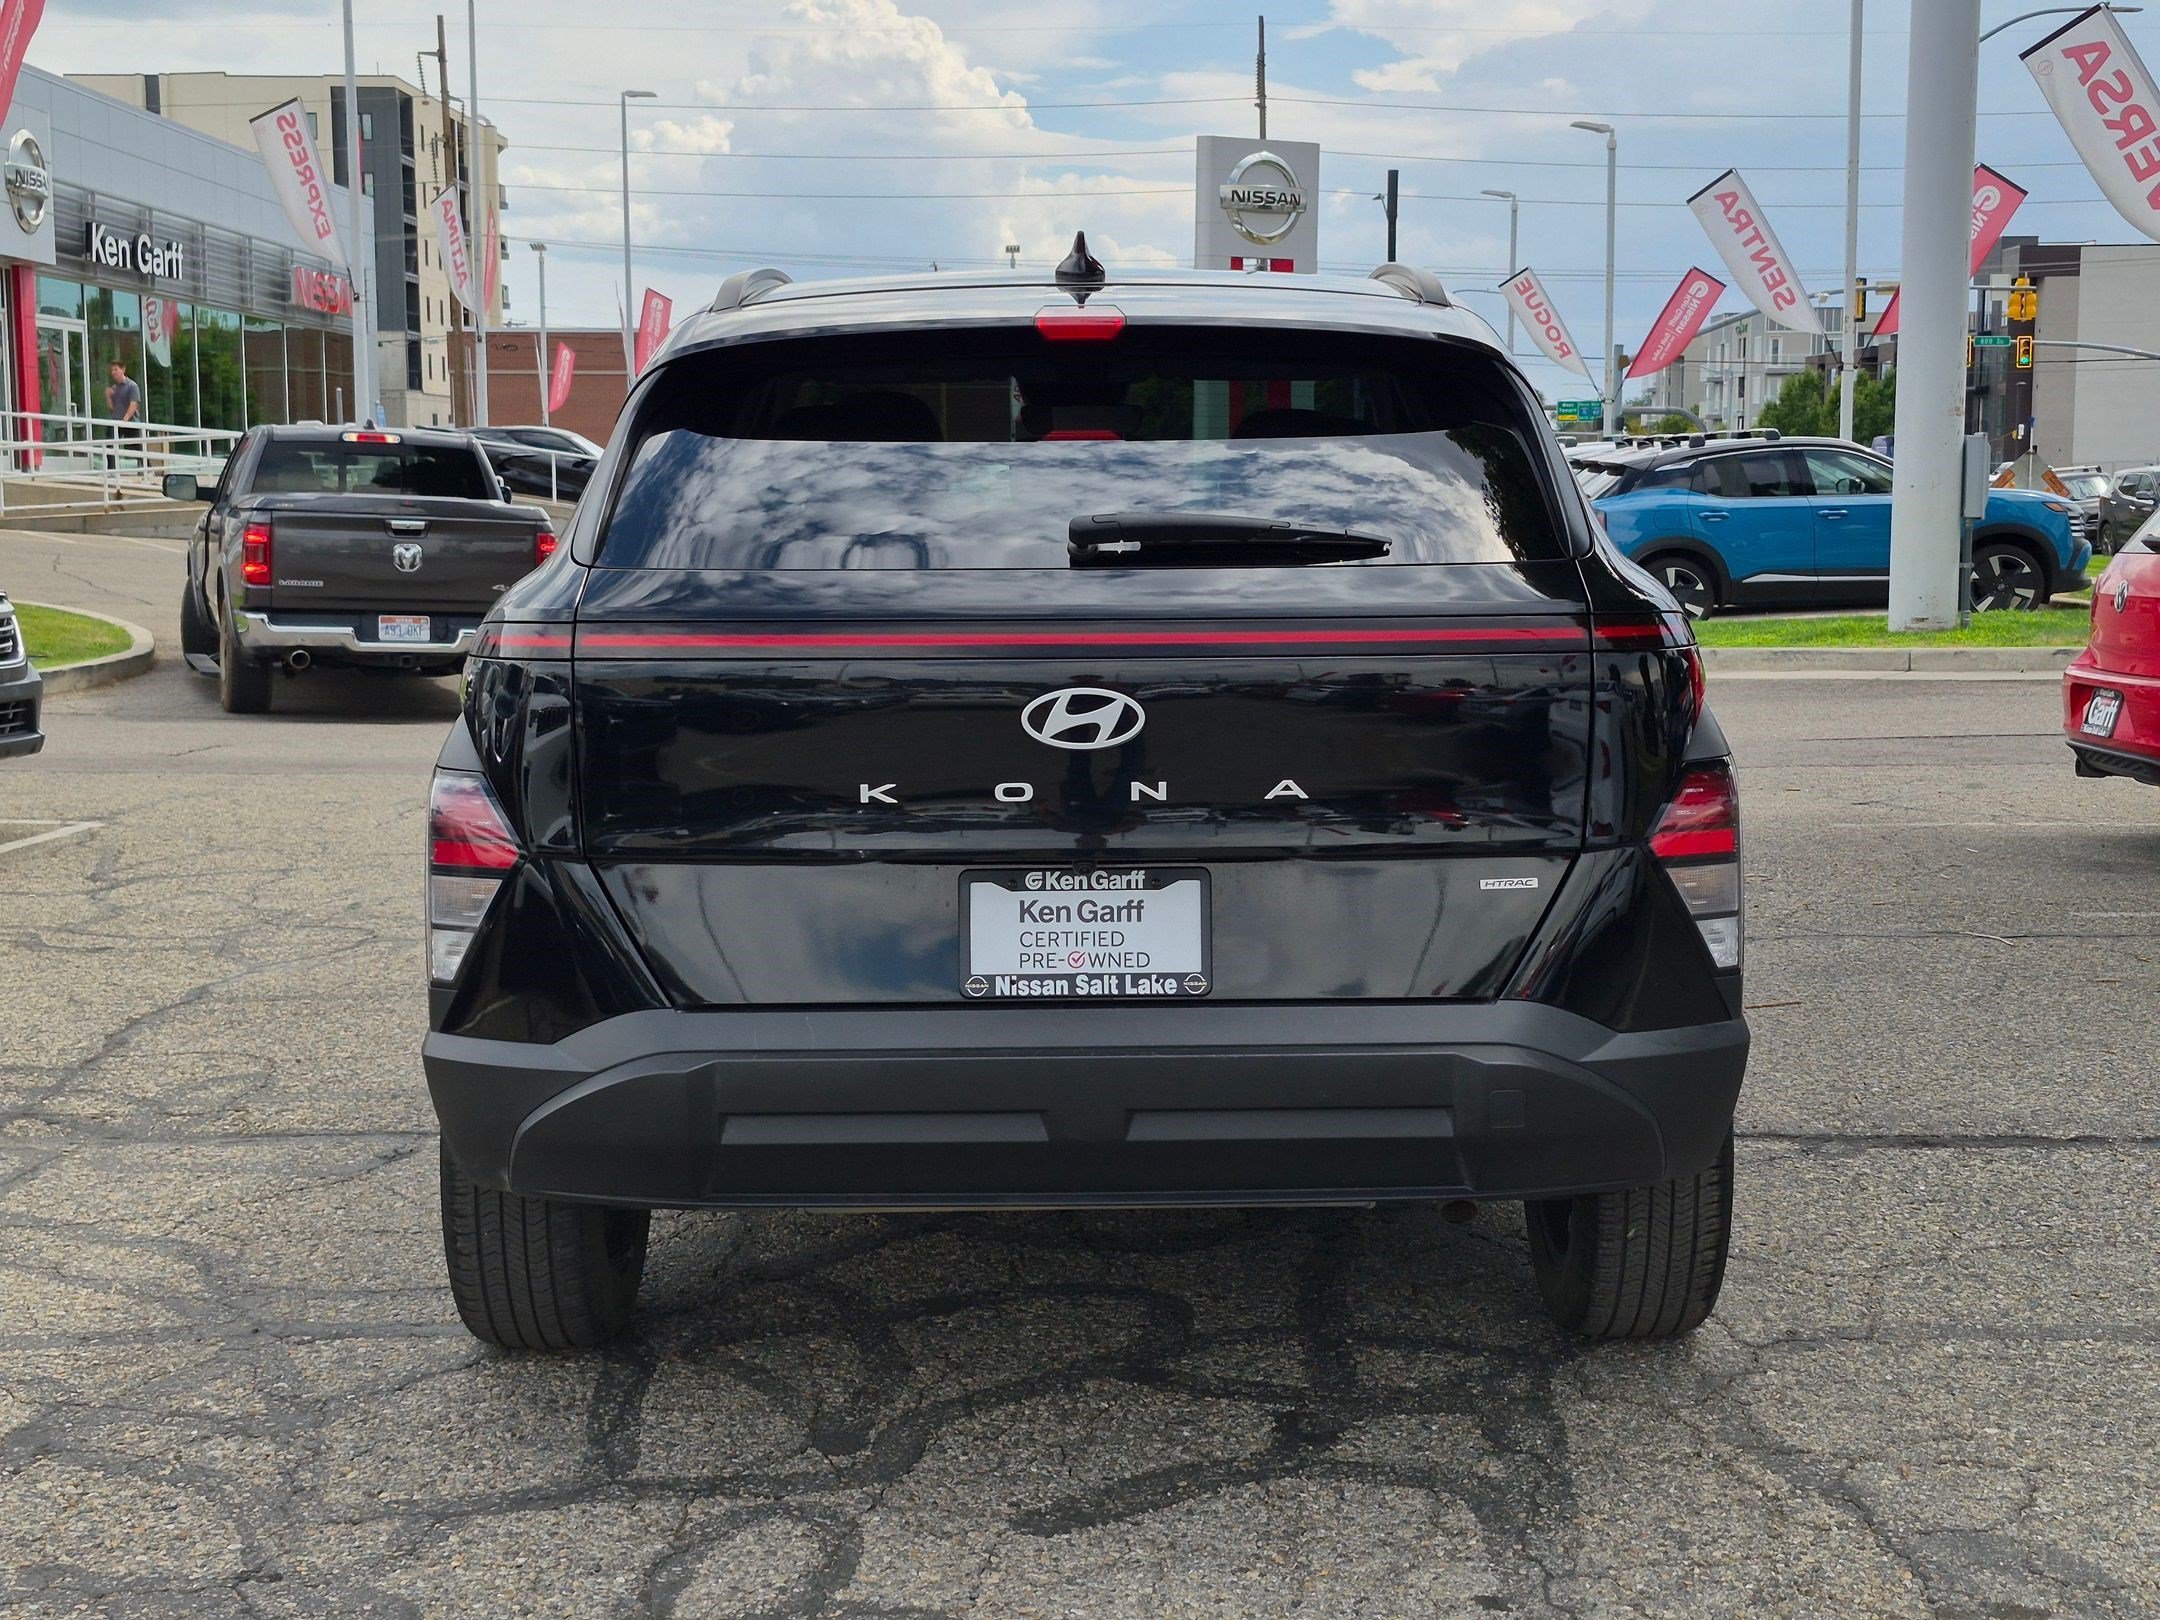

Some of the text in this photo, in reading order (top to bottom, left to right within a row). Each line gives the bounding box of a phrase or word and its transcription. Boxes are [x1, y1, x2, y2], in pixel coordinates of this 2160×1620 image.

[15, 169, 48, 190] NISSA
[1231, 189, 1301, 207] NISSAN
[91, 221, 184, 280] Ken Garff
[295, 265, 353, 318] NISSA
[859, 779, 1309, 803] KONA
[1046, 870, 1145, 890] Ken Garff
[1484, 879, 1534, 888] HTRAC
[1019, 899, 1145, 923] Ken Garff
[1019, 931, 1125, 948] CERTIFIED
[995, 974, 1177, 996] Nissan Salt Lake
